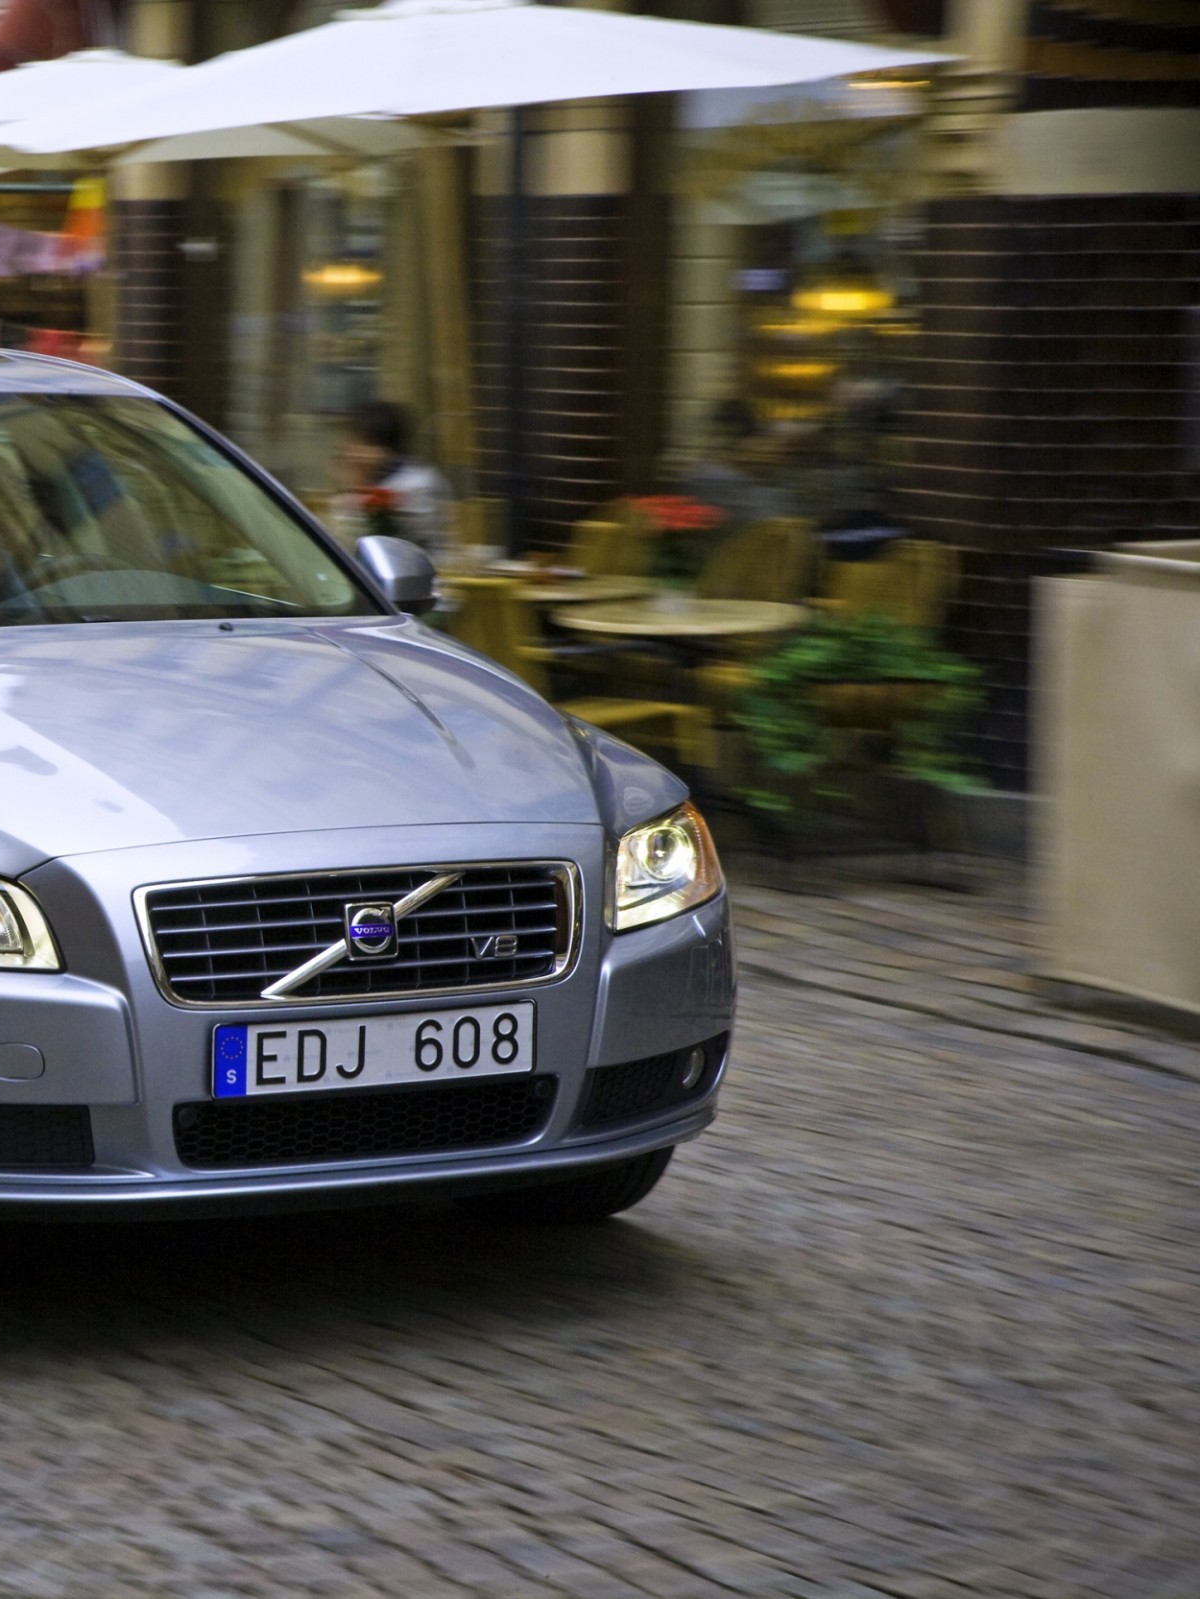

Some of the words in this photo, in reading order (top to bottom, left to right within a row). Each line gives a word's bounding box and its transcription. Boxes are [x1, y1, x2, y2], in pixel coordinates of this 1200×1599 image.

[353, 926, 390, 935] VOLVO
[471, 935, 518, 960] V8
[256, 1025, 366, 1086] EDJ
[414, 1012, 519, 1072] 608
[225, 1068, 238, 1085] S
